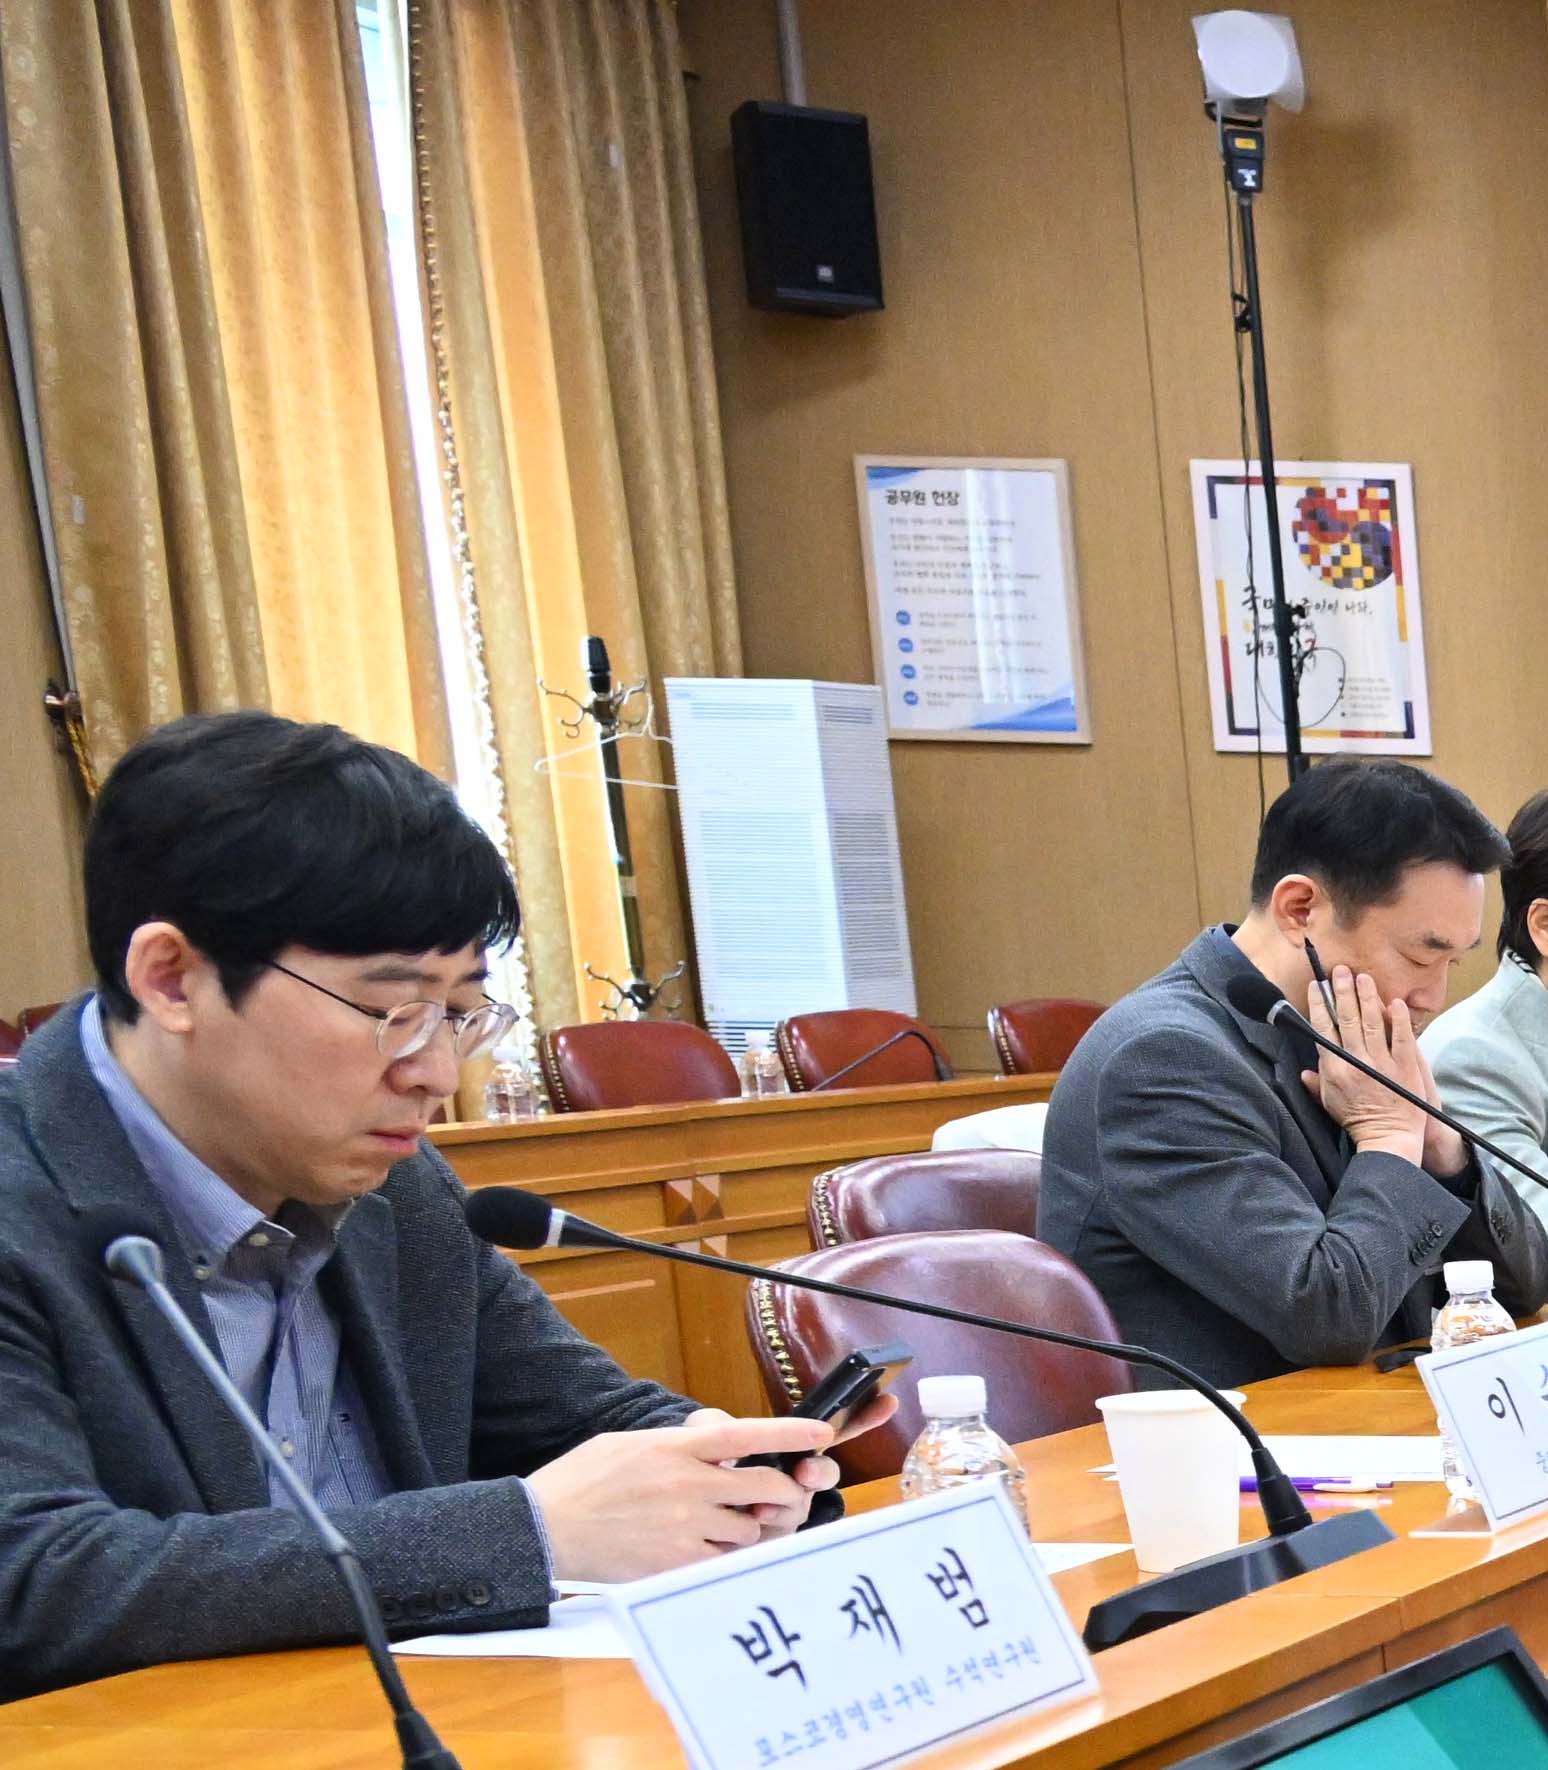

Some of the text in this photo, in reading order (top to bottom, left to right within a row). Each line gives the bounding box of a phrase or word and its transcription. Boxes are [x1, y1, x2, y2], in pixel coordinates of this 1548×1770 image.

[885, 488, 960, 507] 공무원 헌장
[730, 1546, 990, 1693] 박재범
[945, 1636, 1042, 1692] 수석연구원
